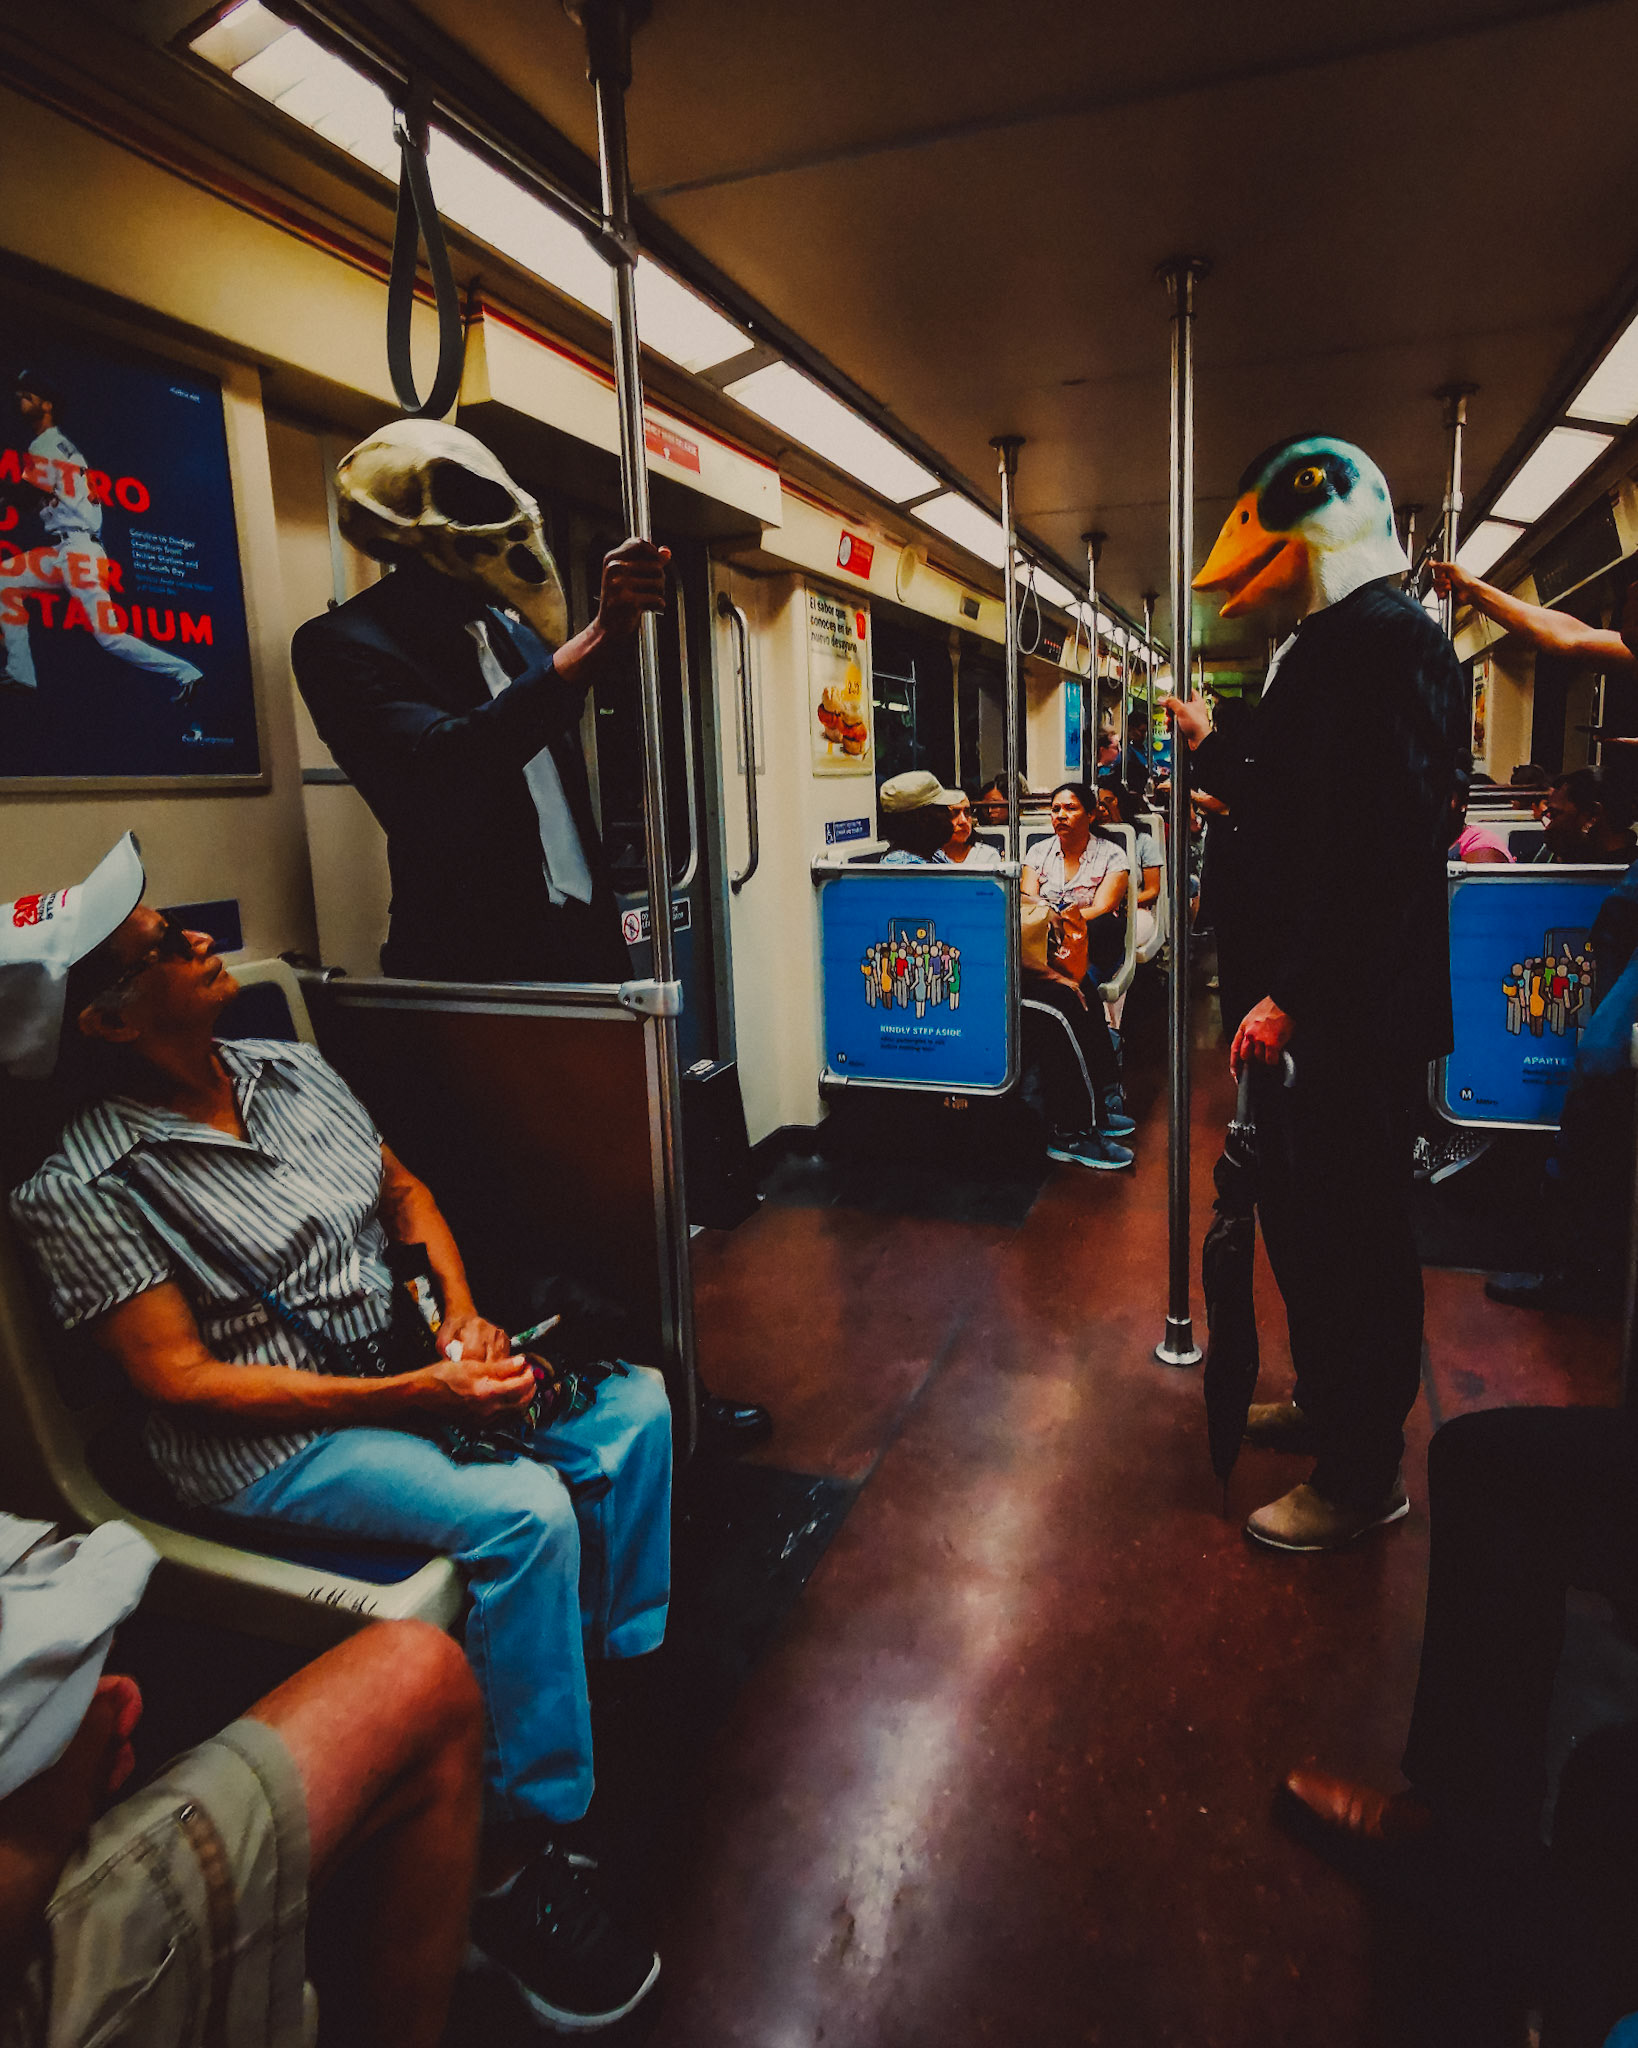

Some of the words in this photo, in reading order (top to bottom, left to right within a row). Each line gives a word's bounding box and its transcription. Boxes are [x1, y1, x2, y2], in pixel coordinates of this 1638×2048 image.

[0, 448, 151, 514] METRO
[0, 586, 214, 646] STADIUM
[880, 1025, 911, 1036] KINDLY
[912, 1026, 934, 1036] STEP
[935, 1027, 962, 1038] ASIDE
